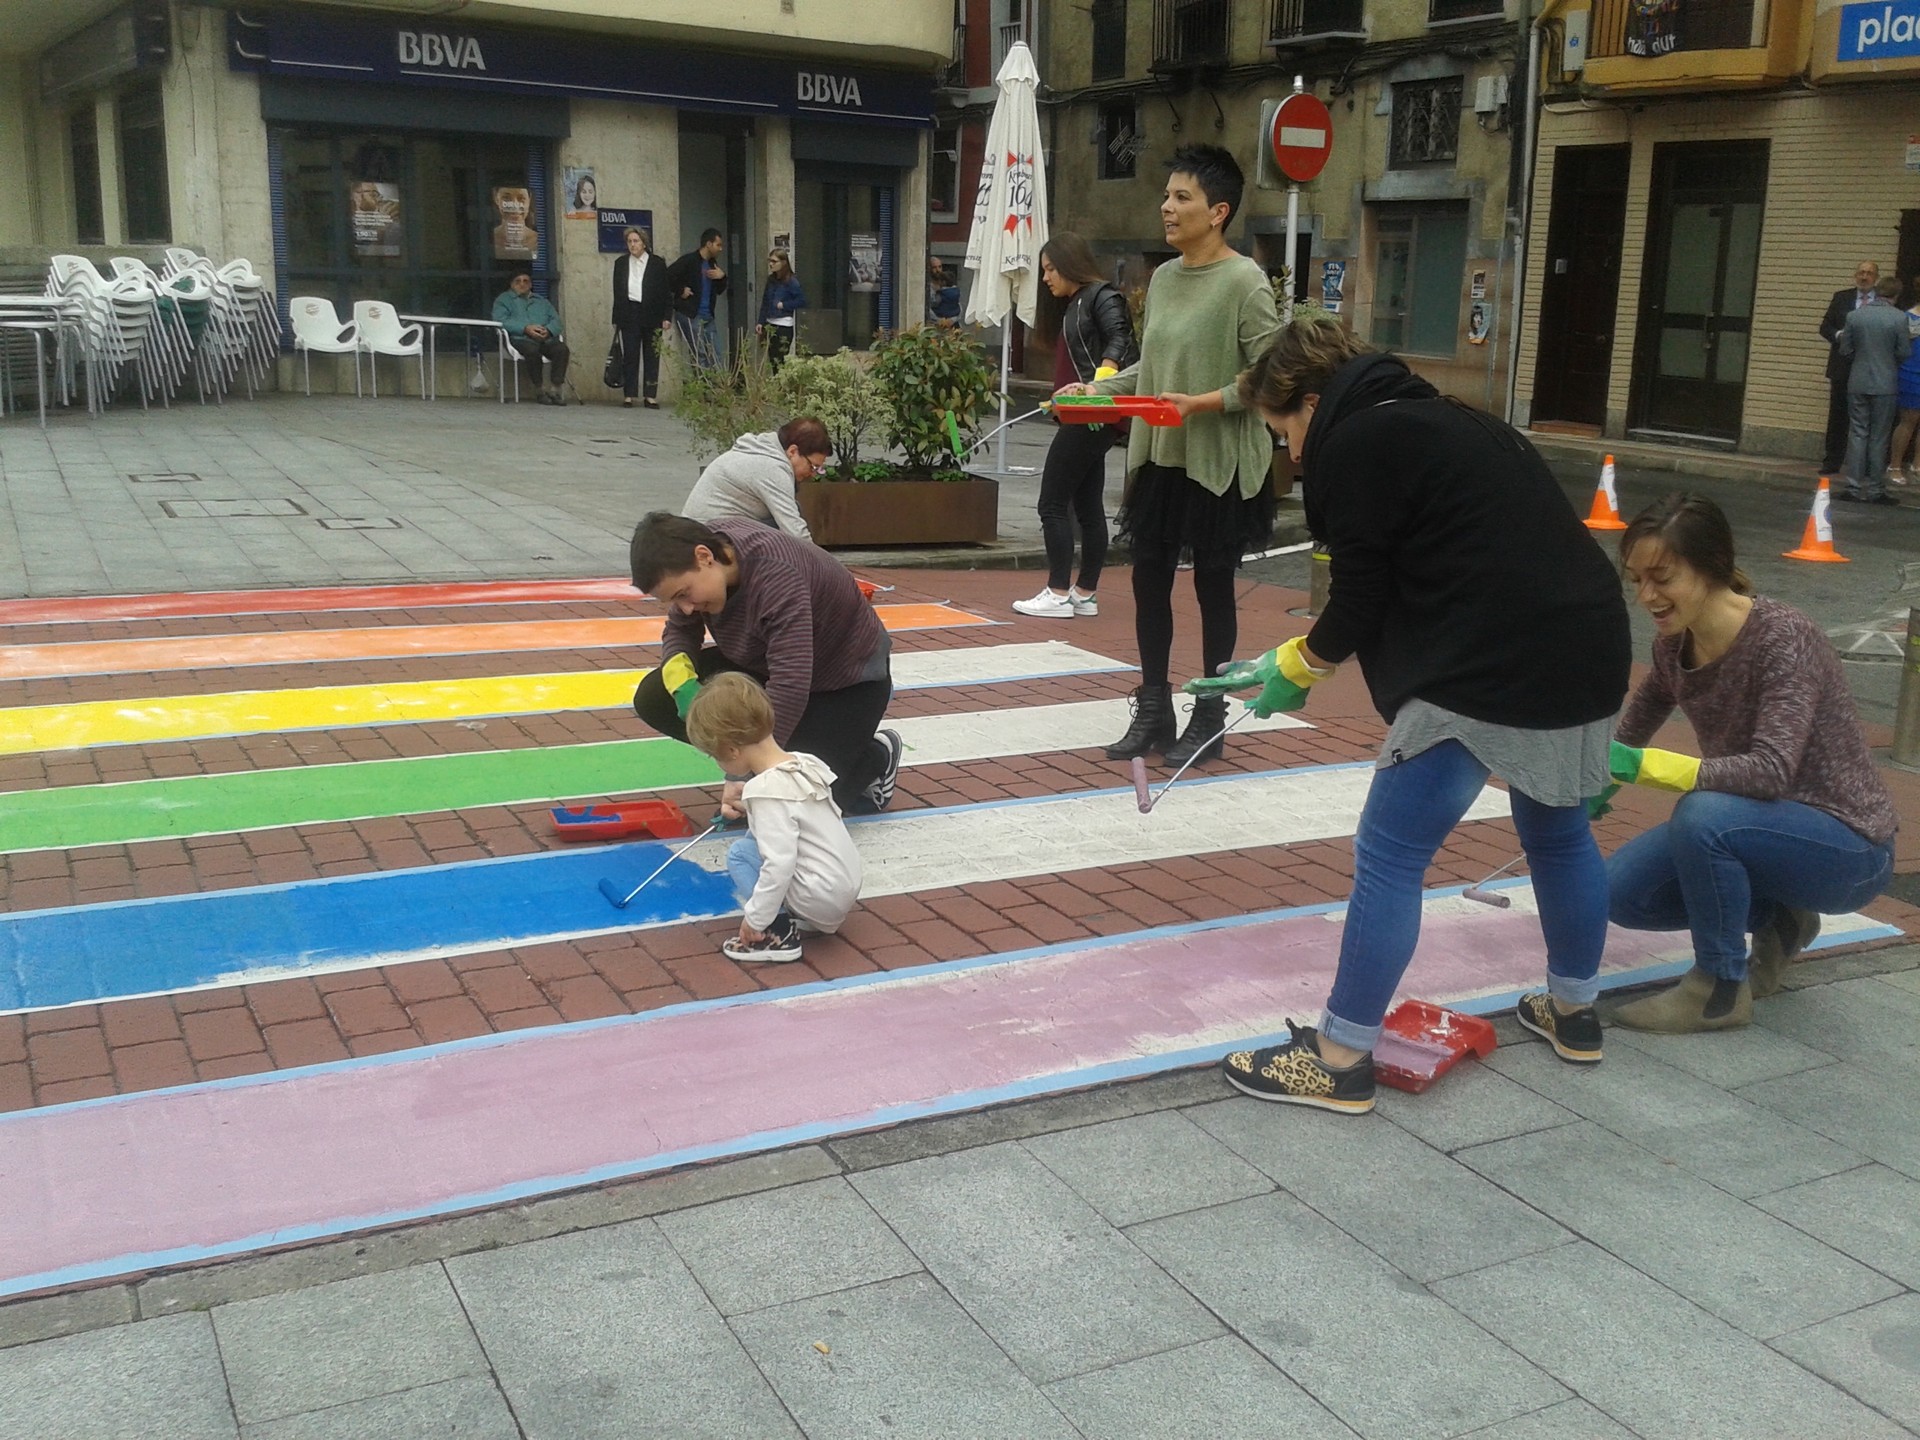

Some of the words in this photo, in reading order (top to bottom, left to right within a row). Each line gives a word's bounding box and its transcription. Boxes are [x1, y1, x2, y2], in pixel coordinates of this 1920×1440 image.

[1857, 6, 1920, 53] pla
[399, 31, 487, 71] BBVA
[797, 72, 862, 106] BBVA
[601, 212, 627, 224] BBVA
